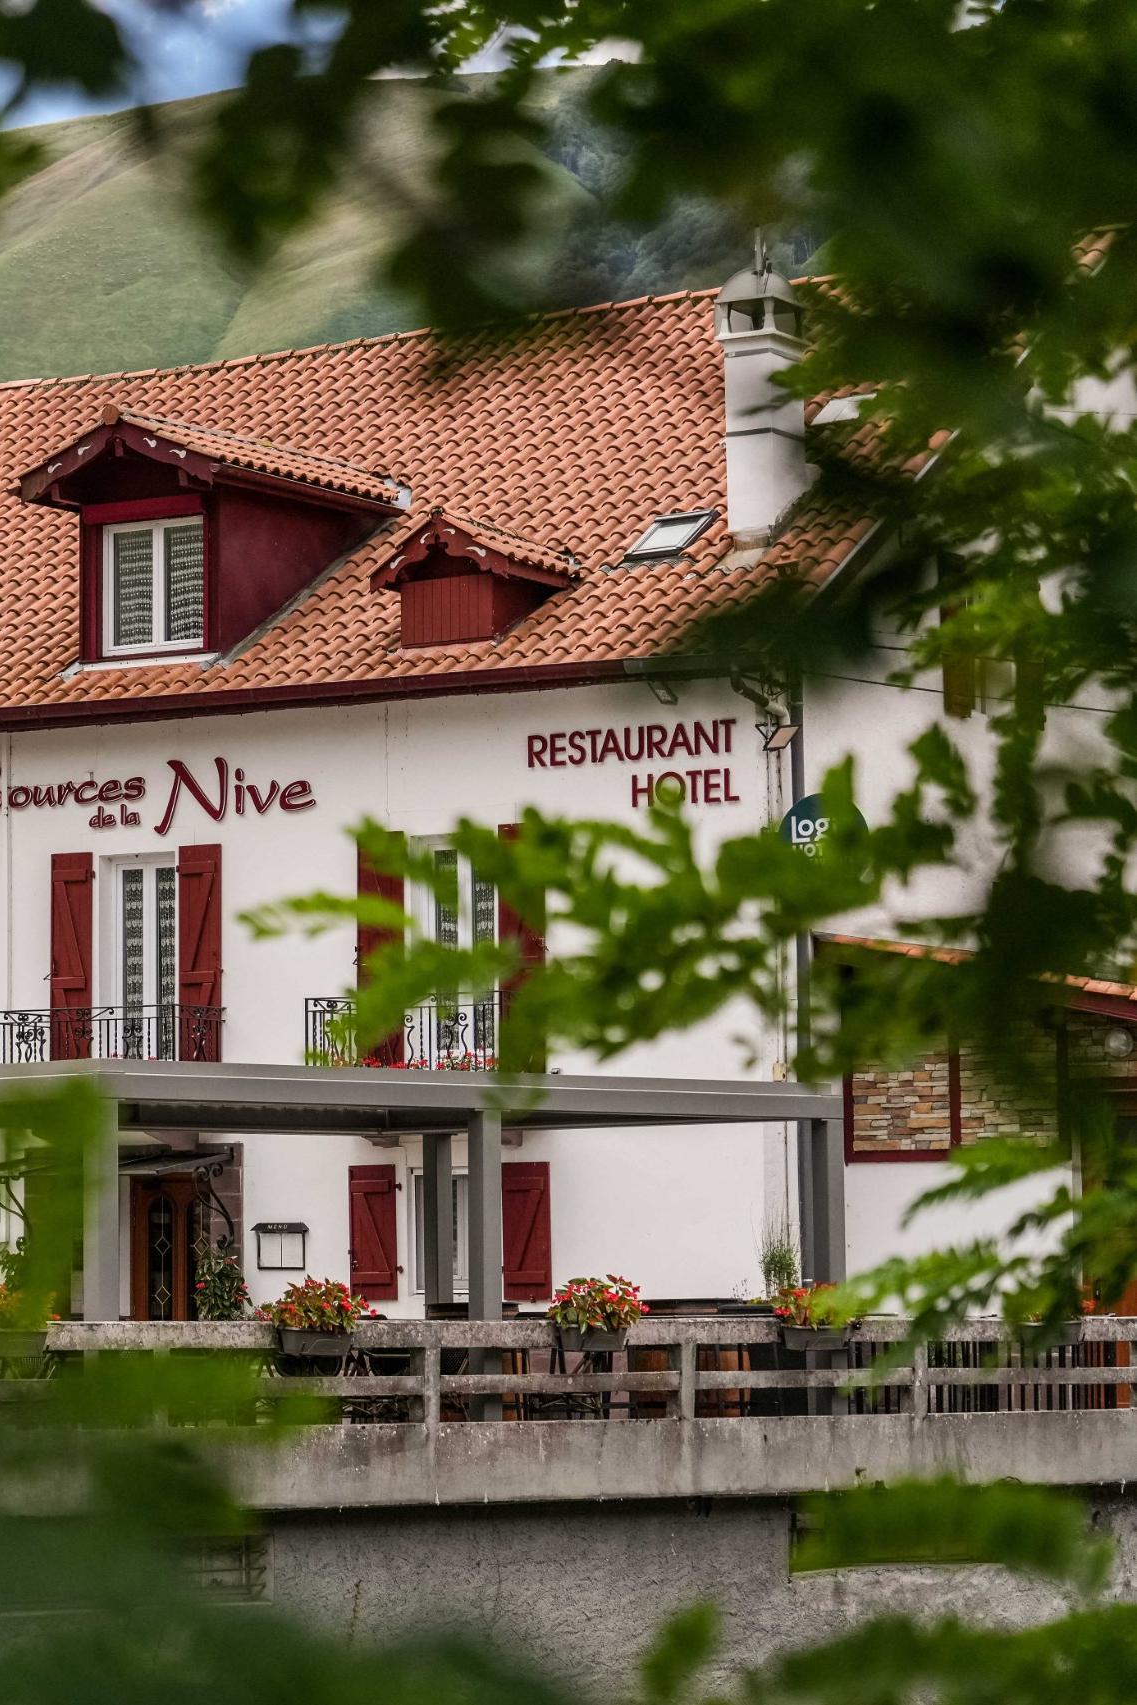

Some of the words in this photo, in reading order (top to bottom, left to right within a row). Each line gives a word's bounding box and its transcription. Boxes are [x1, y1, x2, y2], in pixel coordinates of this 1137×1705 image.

[527, 718, 737, 768] RESTAURANT
[89, 806, 116, 828] de
[120, 804, 141, 826] la
[154, 757, 316, 836] Nive
[631, 768, 740, 808] HOTEL
